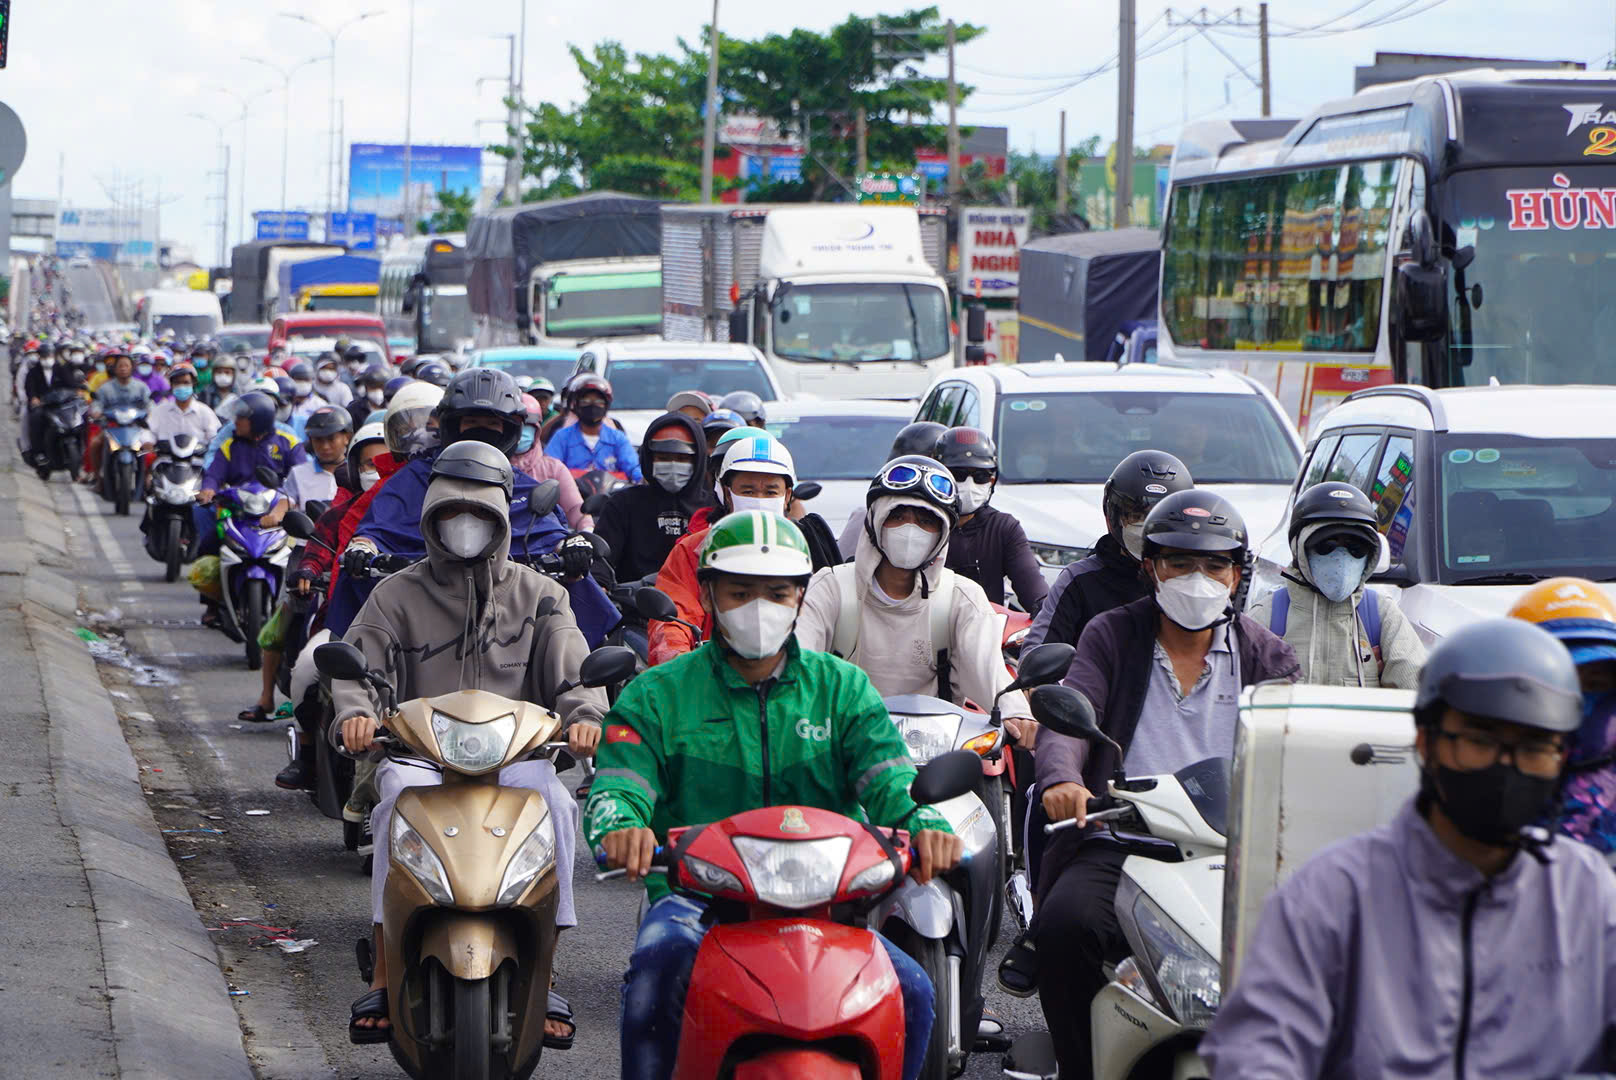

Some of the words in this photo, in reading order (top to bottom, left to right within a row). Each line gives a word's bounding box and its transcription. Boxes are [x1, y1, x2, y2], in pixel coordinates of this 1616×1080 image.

[975, 223, 1016, 247] NHÀ
[779, 923, 824, 937] HONDA
[1114, 1002, 1149, 1031] HONDA
